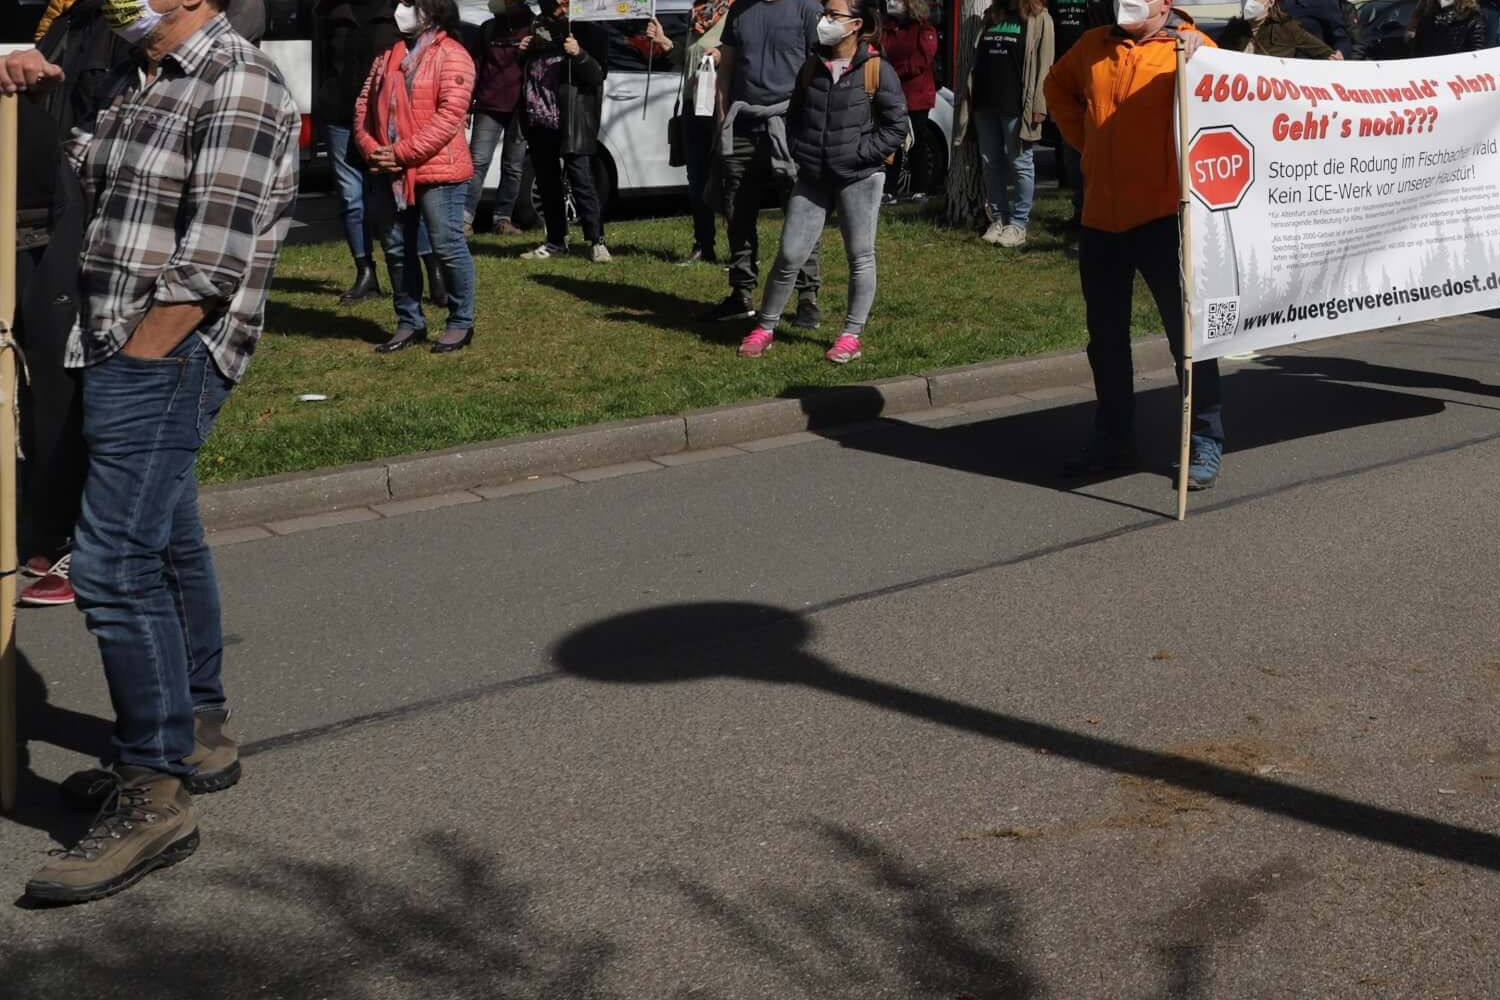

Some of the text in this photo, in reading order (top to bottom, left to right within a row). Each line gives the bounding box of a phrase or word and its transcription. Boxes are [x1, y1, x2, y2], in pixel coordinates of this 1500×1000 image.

[1446, 73, 1497, 101] platt
[1359, 105, 1438, 137] noch???
[1195, 154, 1243, 183] STOP
[1268, 160, 1319, 182] Stoppt
[1323, 158, 1345, 176] die
[1350, 155, 1398, 175] Rodung
[1401, 156, 1416, 169] im
[1268, 187, 1302, 205] Kein
[1307, 181, 1373, 203] ICE-Werk
[1376, 182, 1395, 196] vor
[1397, 175, 1436, 194] unserer
